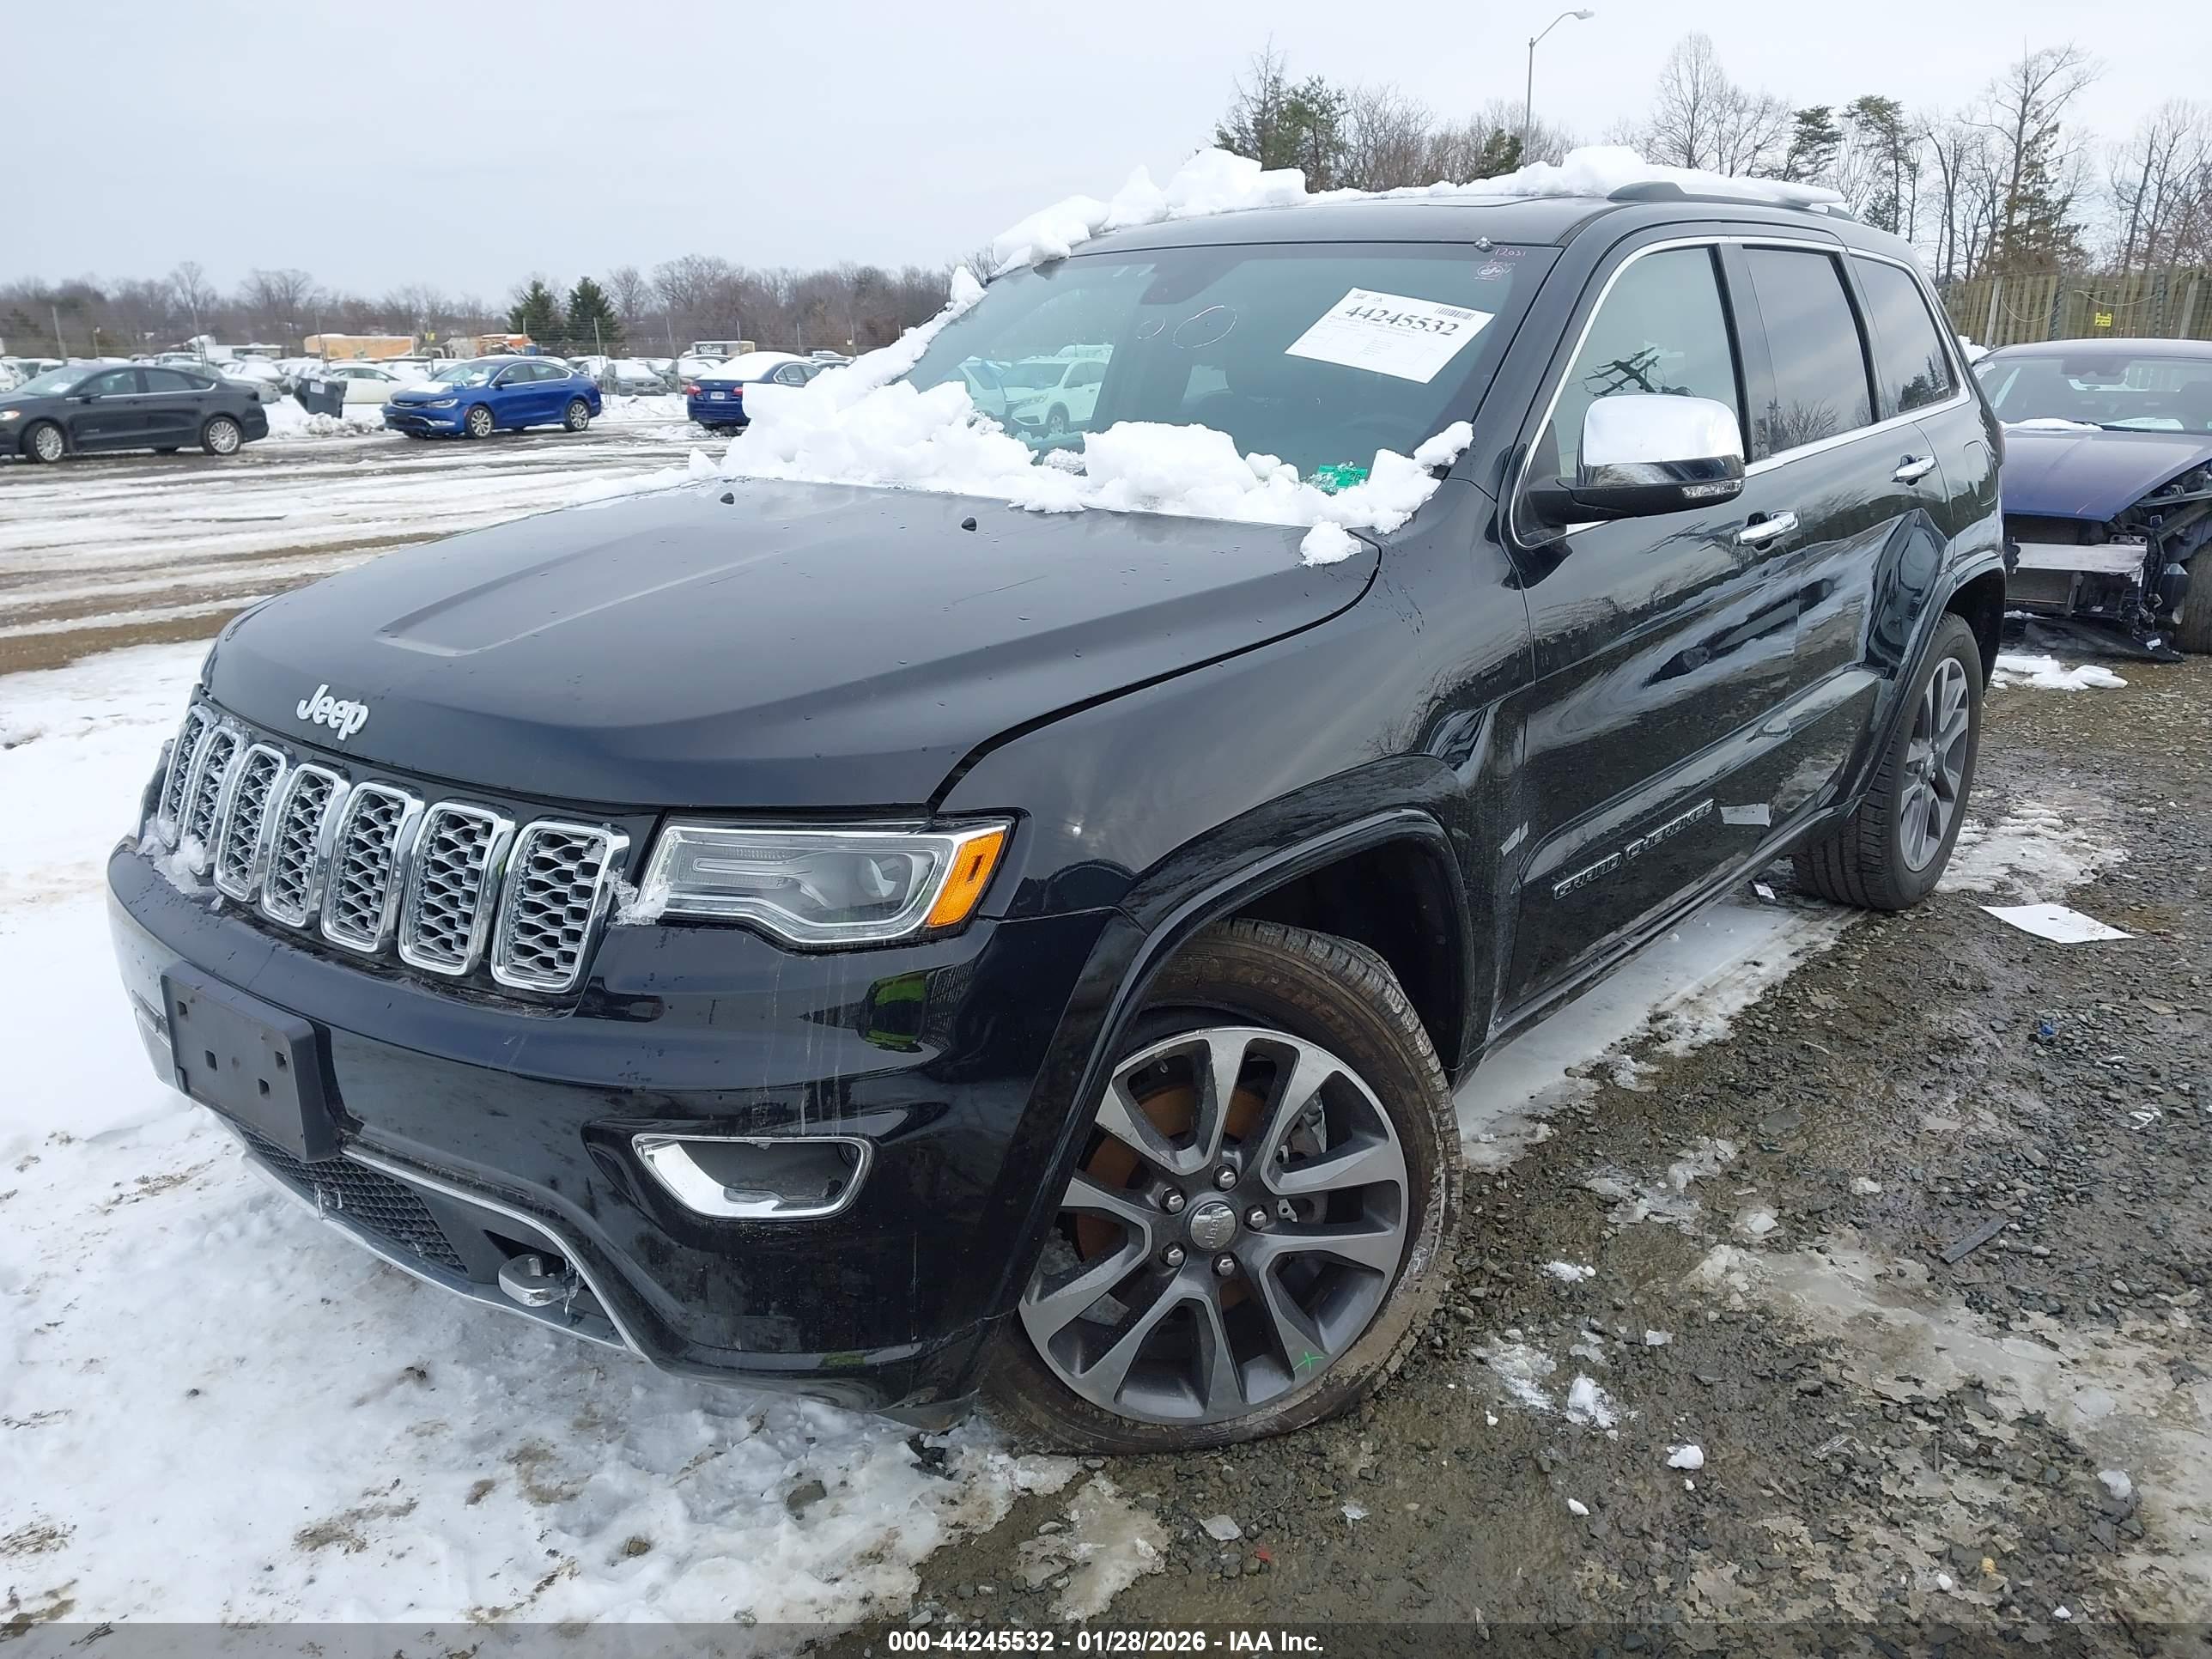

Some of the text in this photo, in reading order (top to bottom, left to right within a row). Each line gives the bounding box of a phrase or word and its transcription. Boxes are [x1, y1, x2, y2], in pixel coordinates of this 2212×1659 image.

[1345, 305, 1460, 336] 44245532
[296, 684, 369, 741] Jeep
[1552, 799, 1715, 900] GRAND CHEROKEE
